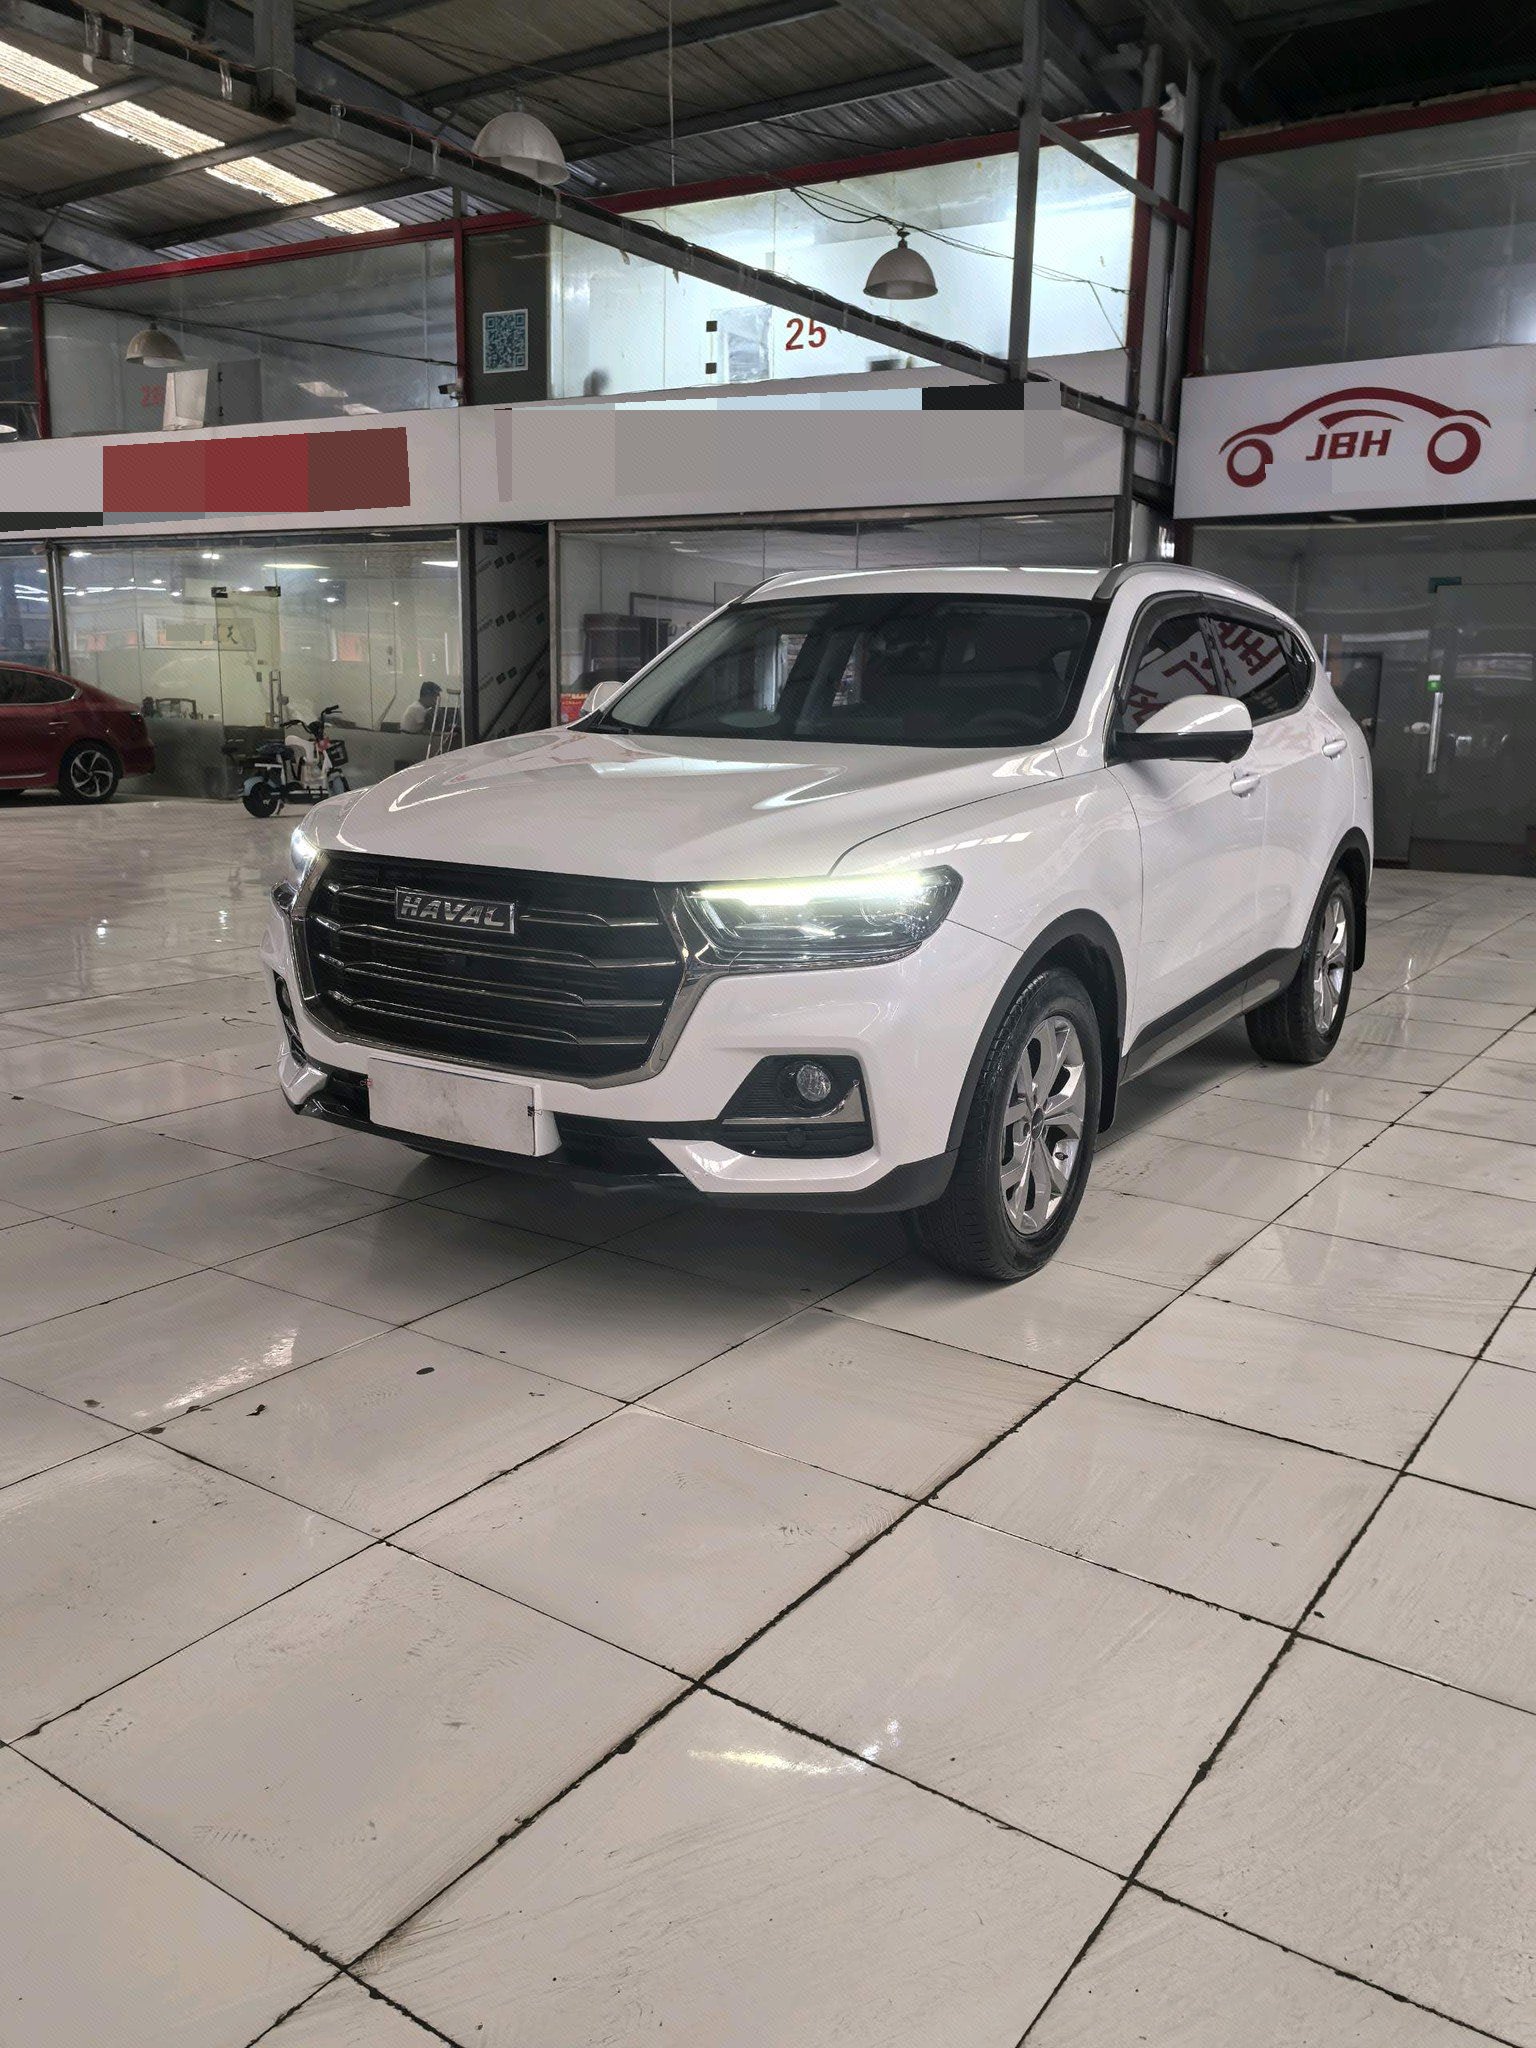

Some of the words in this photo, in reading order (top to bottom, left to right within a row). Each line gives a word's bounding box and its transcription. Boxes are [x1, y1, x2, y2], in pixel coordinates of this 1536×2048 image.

[785, 317, 826, 350] 25
[1306, 429, 1392, 461] JBH
[400, 895, 505, 927] HAVAL
